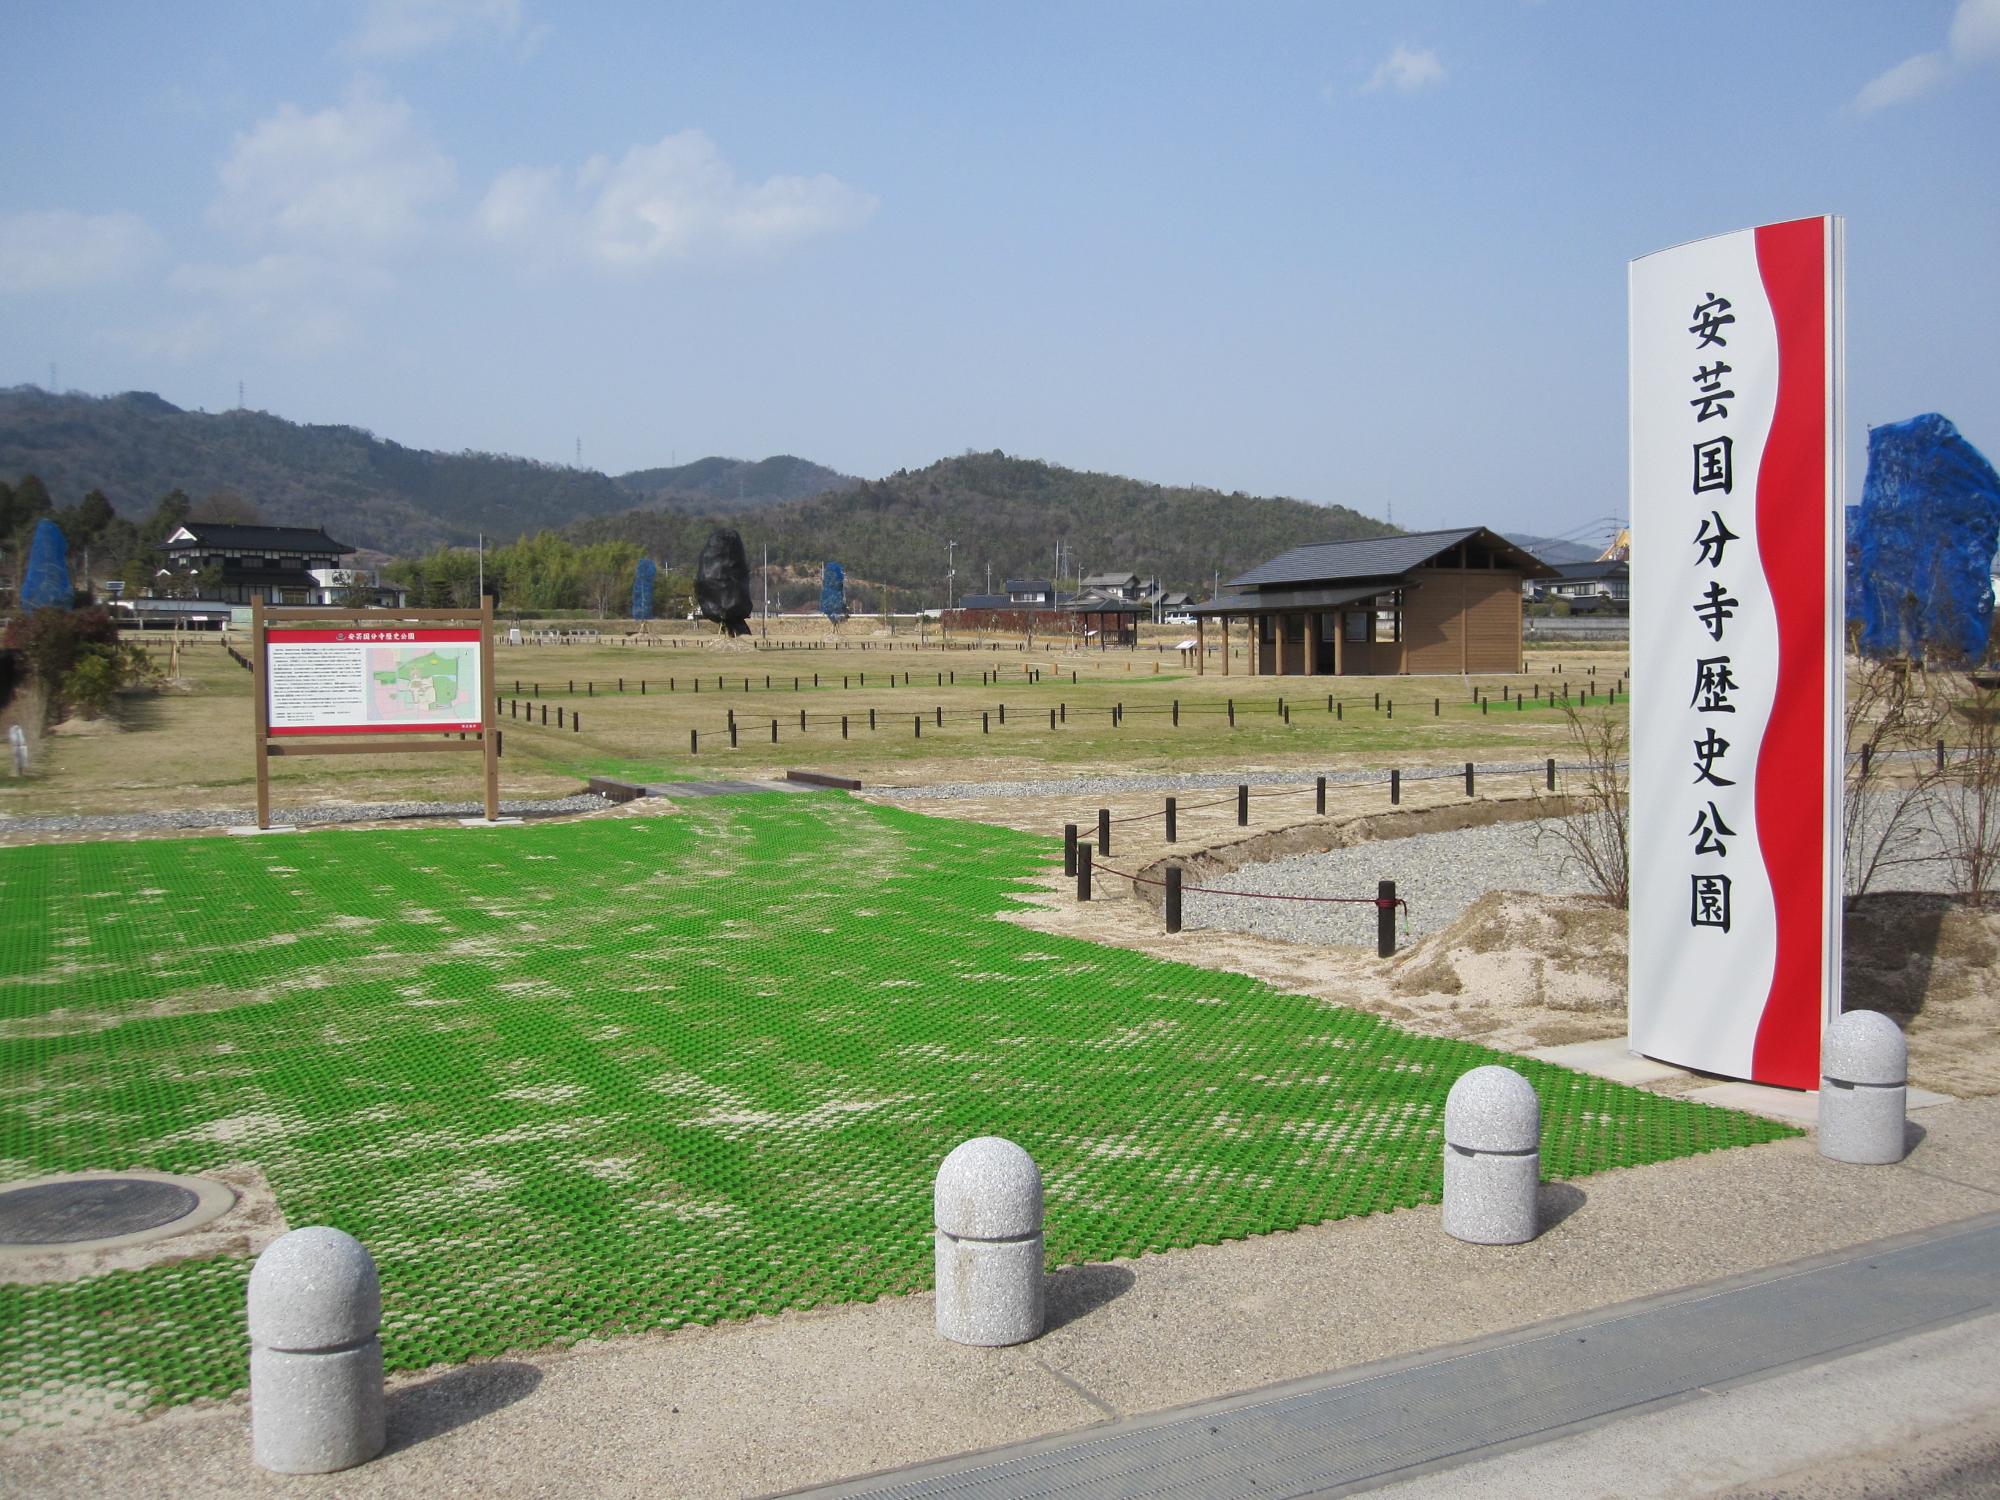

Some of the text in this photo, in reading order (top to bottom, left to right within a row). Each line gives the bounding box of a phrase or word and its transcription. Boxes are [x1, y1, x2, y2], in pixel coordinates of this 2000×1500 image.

[1689, 292, 1740, 933] 安芸国分寺歴史公園
